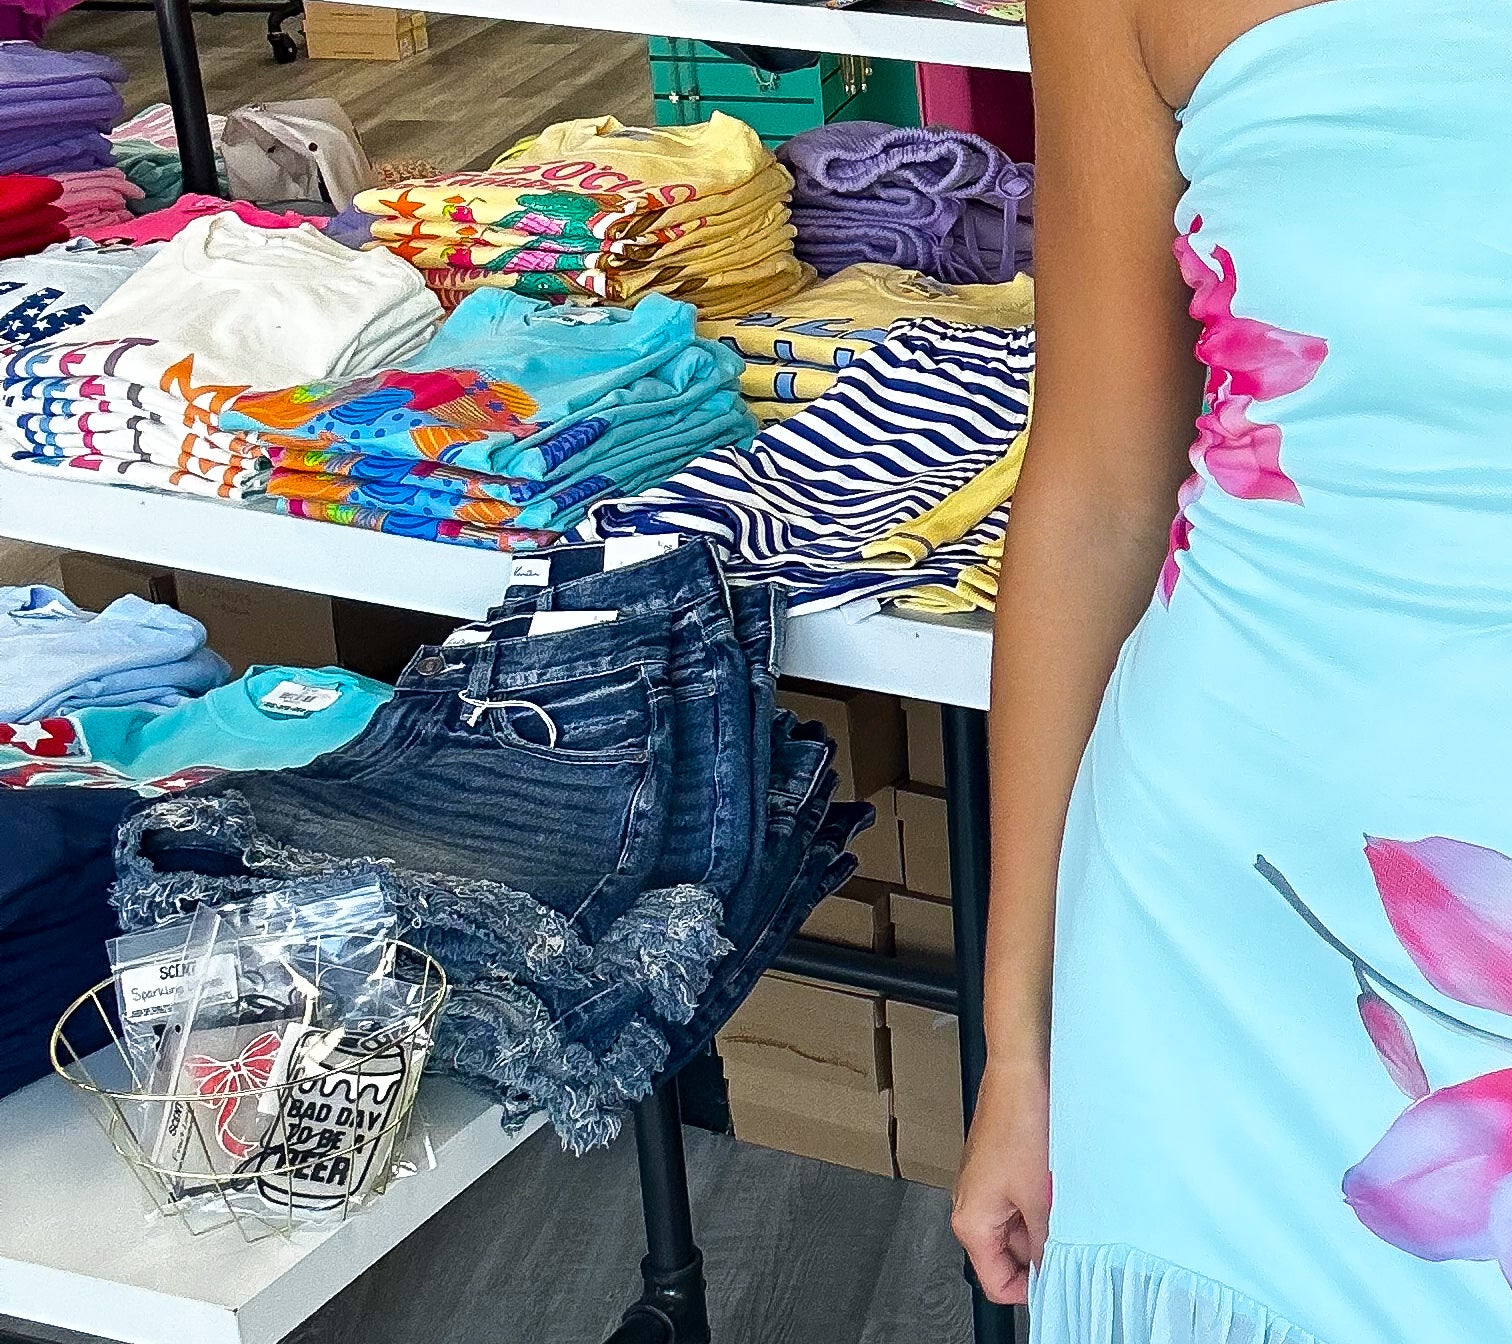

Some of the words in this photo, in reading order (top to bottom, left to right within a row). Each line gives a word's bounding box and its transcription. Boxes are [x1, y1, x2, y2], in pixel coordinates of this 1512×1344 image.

[286, 1099, 333, 1123] BAD
[335, 1107, 383, 1132] DAY
[315, 1128, 348, 1150] BE
